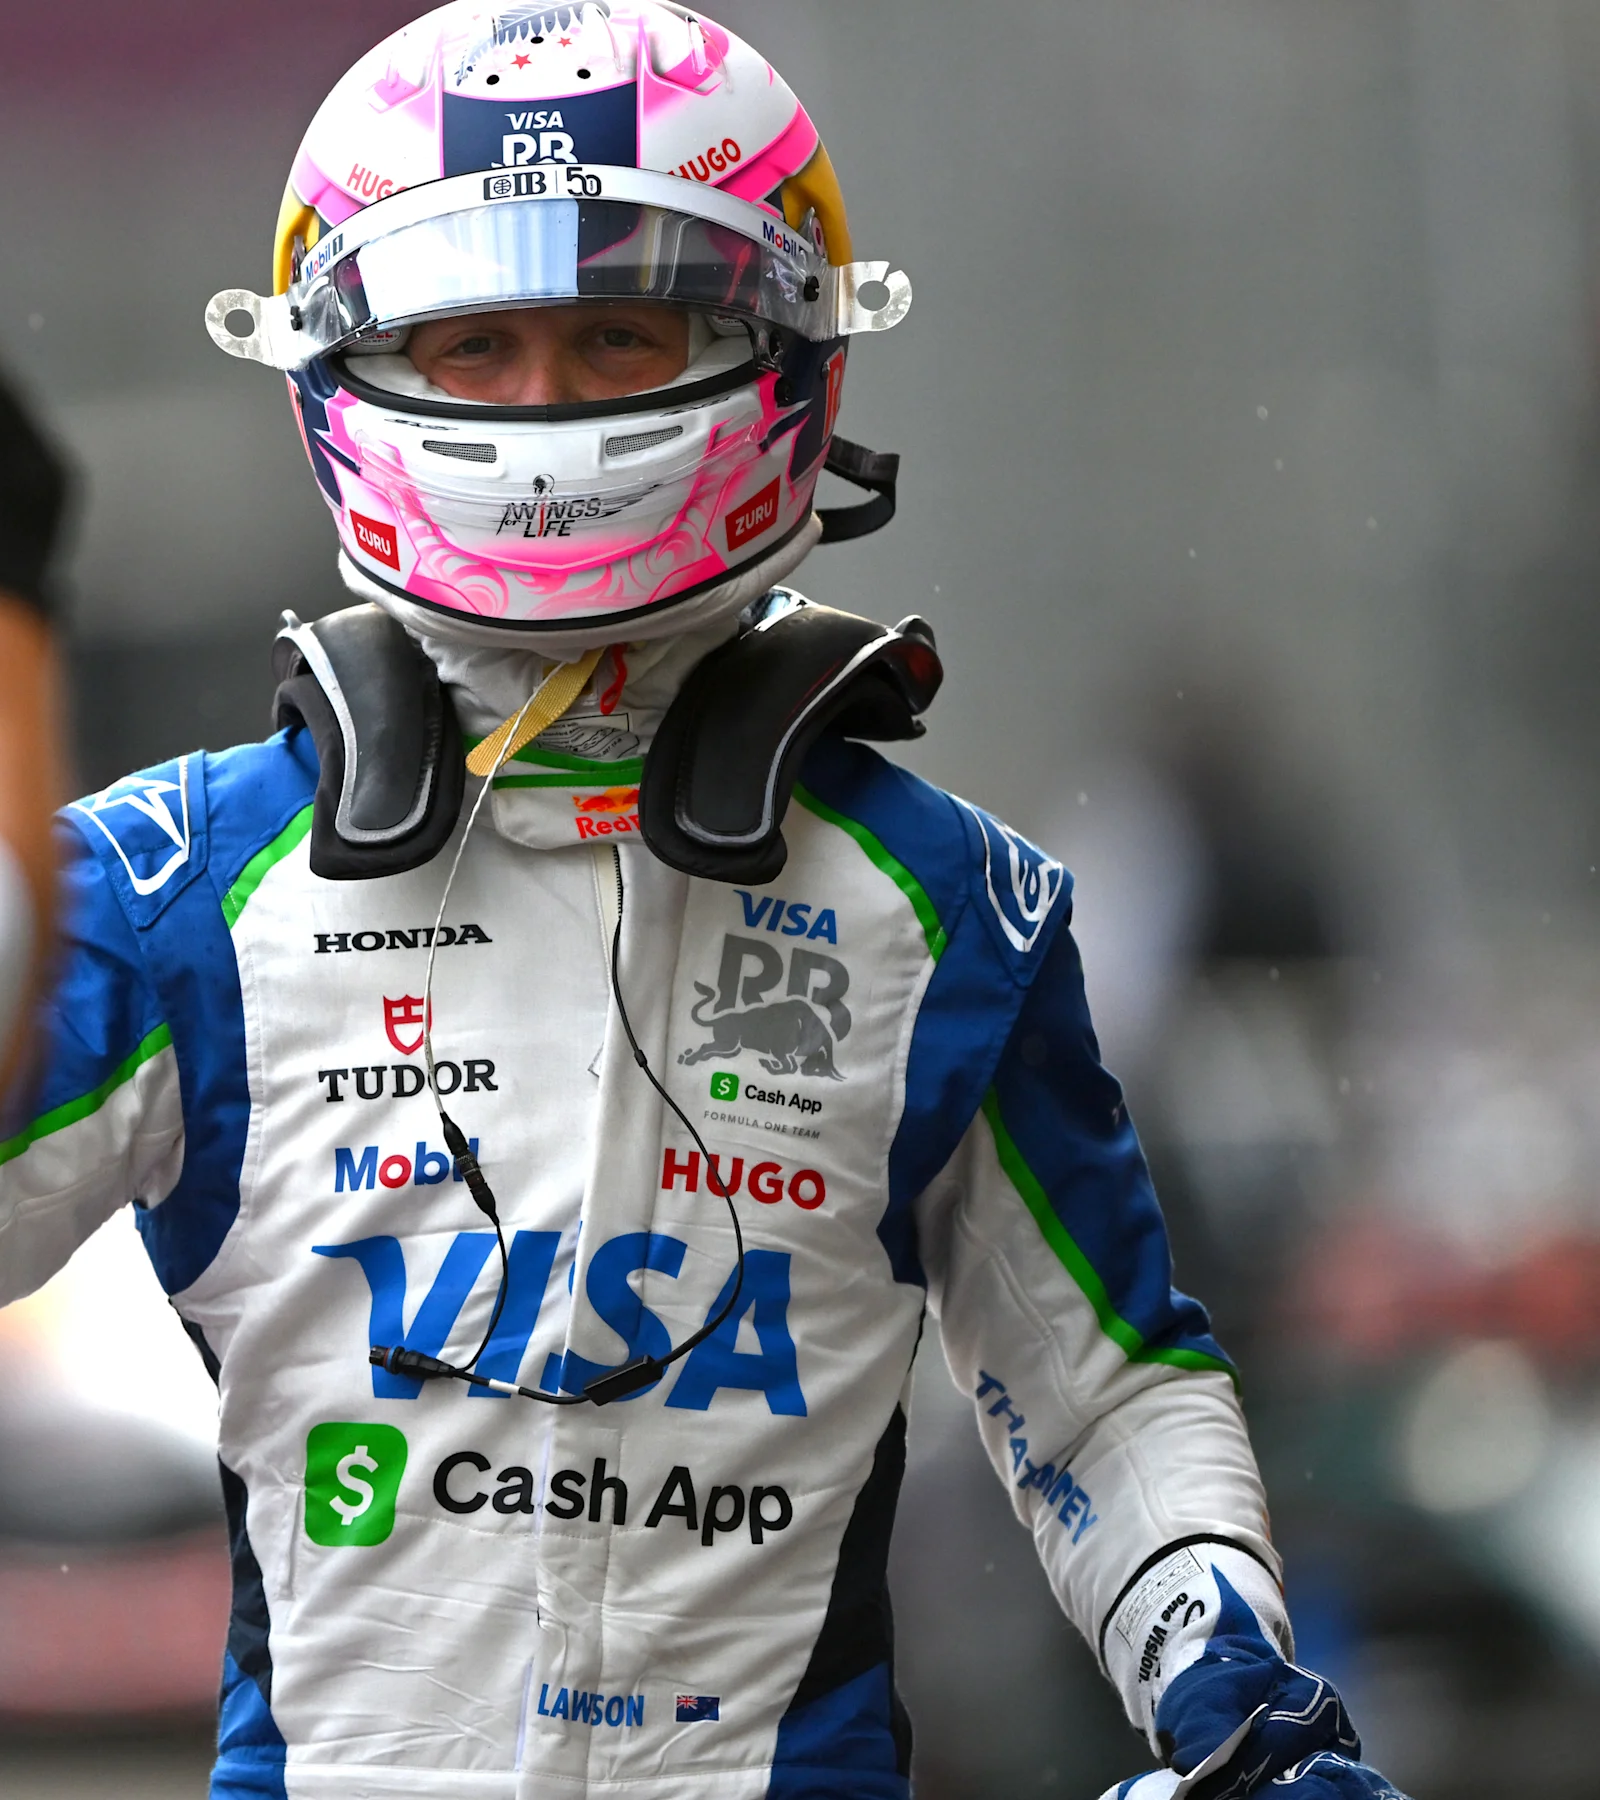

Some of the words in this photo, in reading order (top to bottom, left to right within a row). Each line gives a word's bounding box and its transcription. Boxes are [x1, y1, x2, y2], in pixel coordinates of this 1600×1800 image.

[504, 110, 564, 131] VISA
[566, 167, 602, 197] 50
[762, 220, 797, 257] Mobil
[305, 243, 331, 283] Mobil
[523, 519, 576, 539] LIFE
[735, 498, 774, 537] ZURU
[356, 522, 392, 556] ZURU
[733, 889, 838, 945] VISA
[313, 924, 493, 954] HONDA
[713, 932, 852, 1043] RB
[318, 1059, 499, 1103] TUDOR
[744, 1084, 786, 1106] Cash
[788, 1093, 823, 1115] App
[703, 1110, 759, 1128] FORMULA
[764, 1121, 788, 1133] ONE
[792, 1126, 821, 1140] TEAM
[661, 1147, 827, 1211] HUGO
[311, 1226, 808, 1418] VISA
[432, 1450, 629, 1526] Cash
[645, 1465, 794, 1547] App
[1161, 1592, 1189, 1622] One
[537, 1683, 644, 1727] LAWSON
